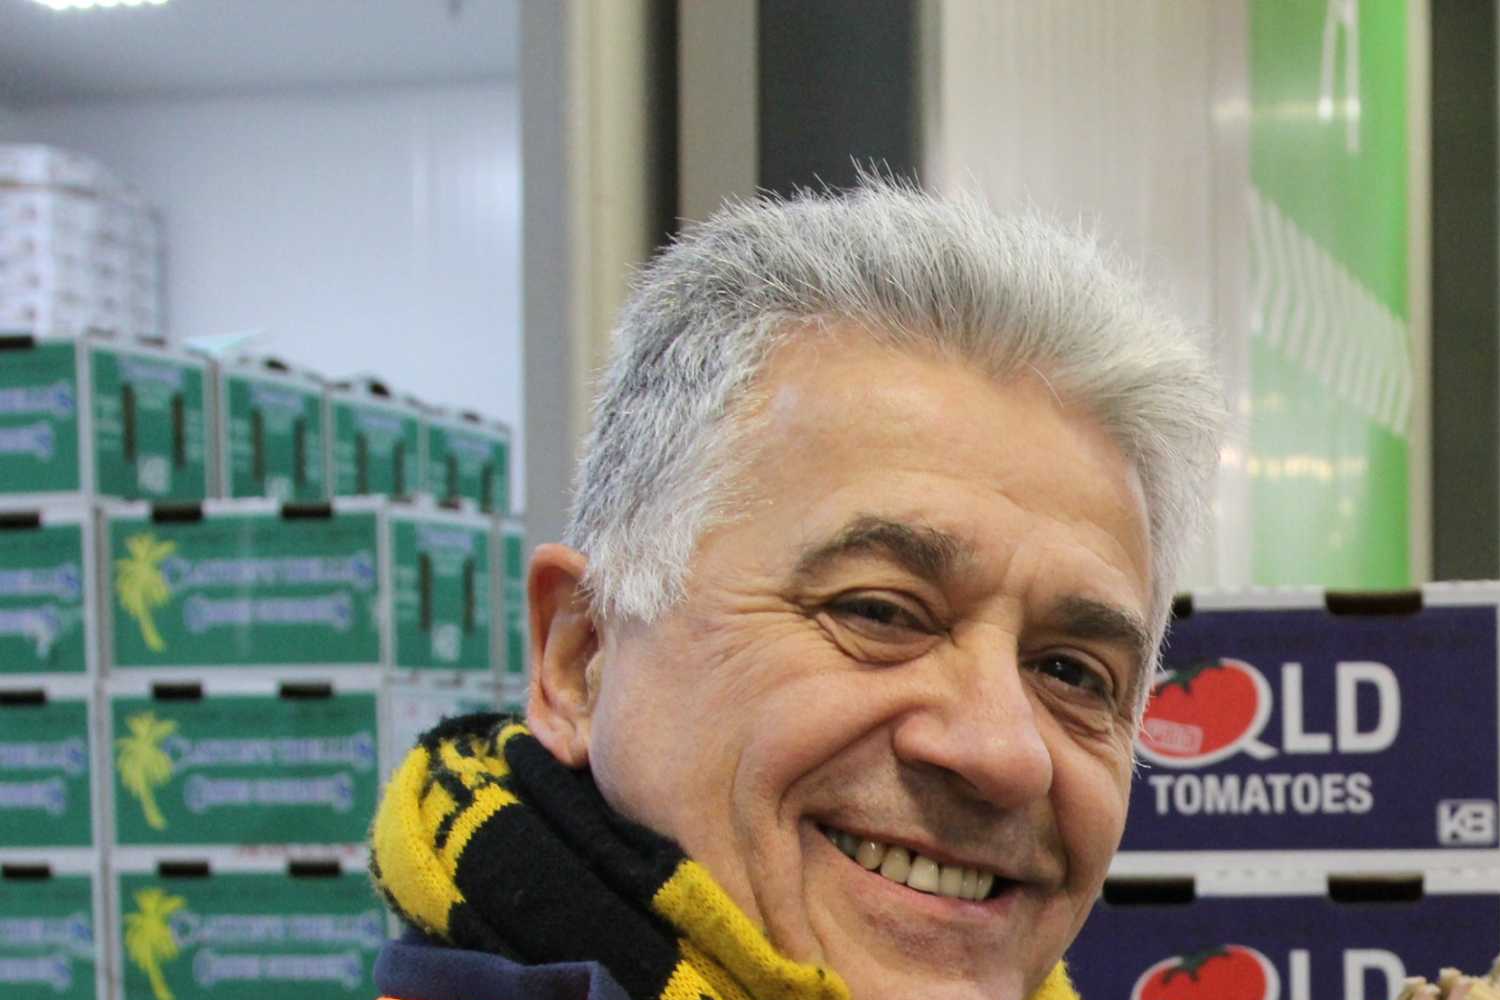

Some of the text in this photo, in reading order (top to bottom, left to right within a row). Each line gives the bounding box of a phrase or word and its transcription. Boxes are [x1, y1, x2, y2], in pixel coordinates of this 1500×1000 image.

[1134, 657, 1401, 768] QLD
[1149, 773, 1374, 815] TOMATOES
[1437, 799, 1497, 845] KB
